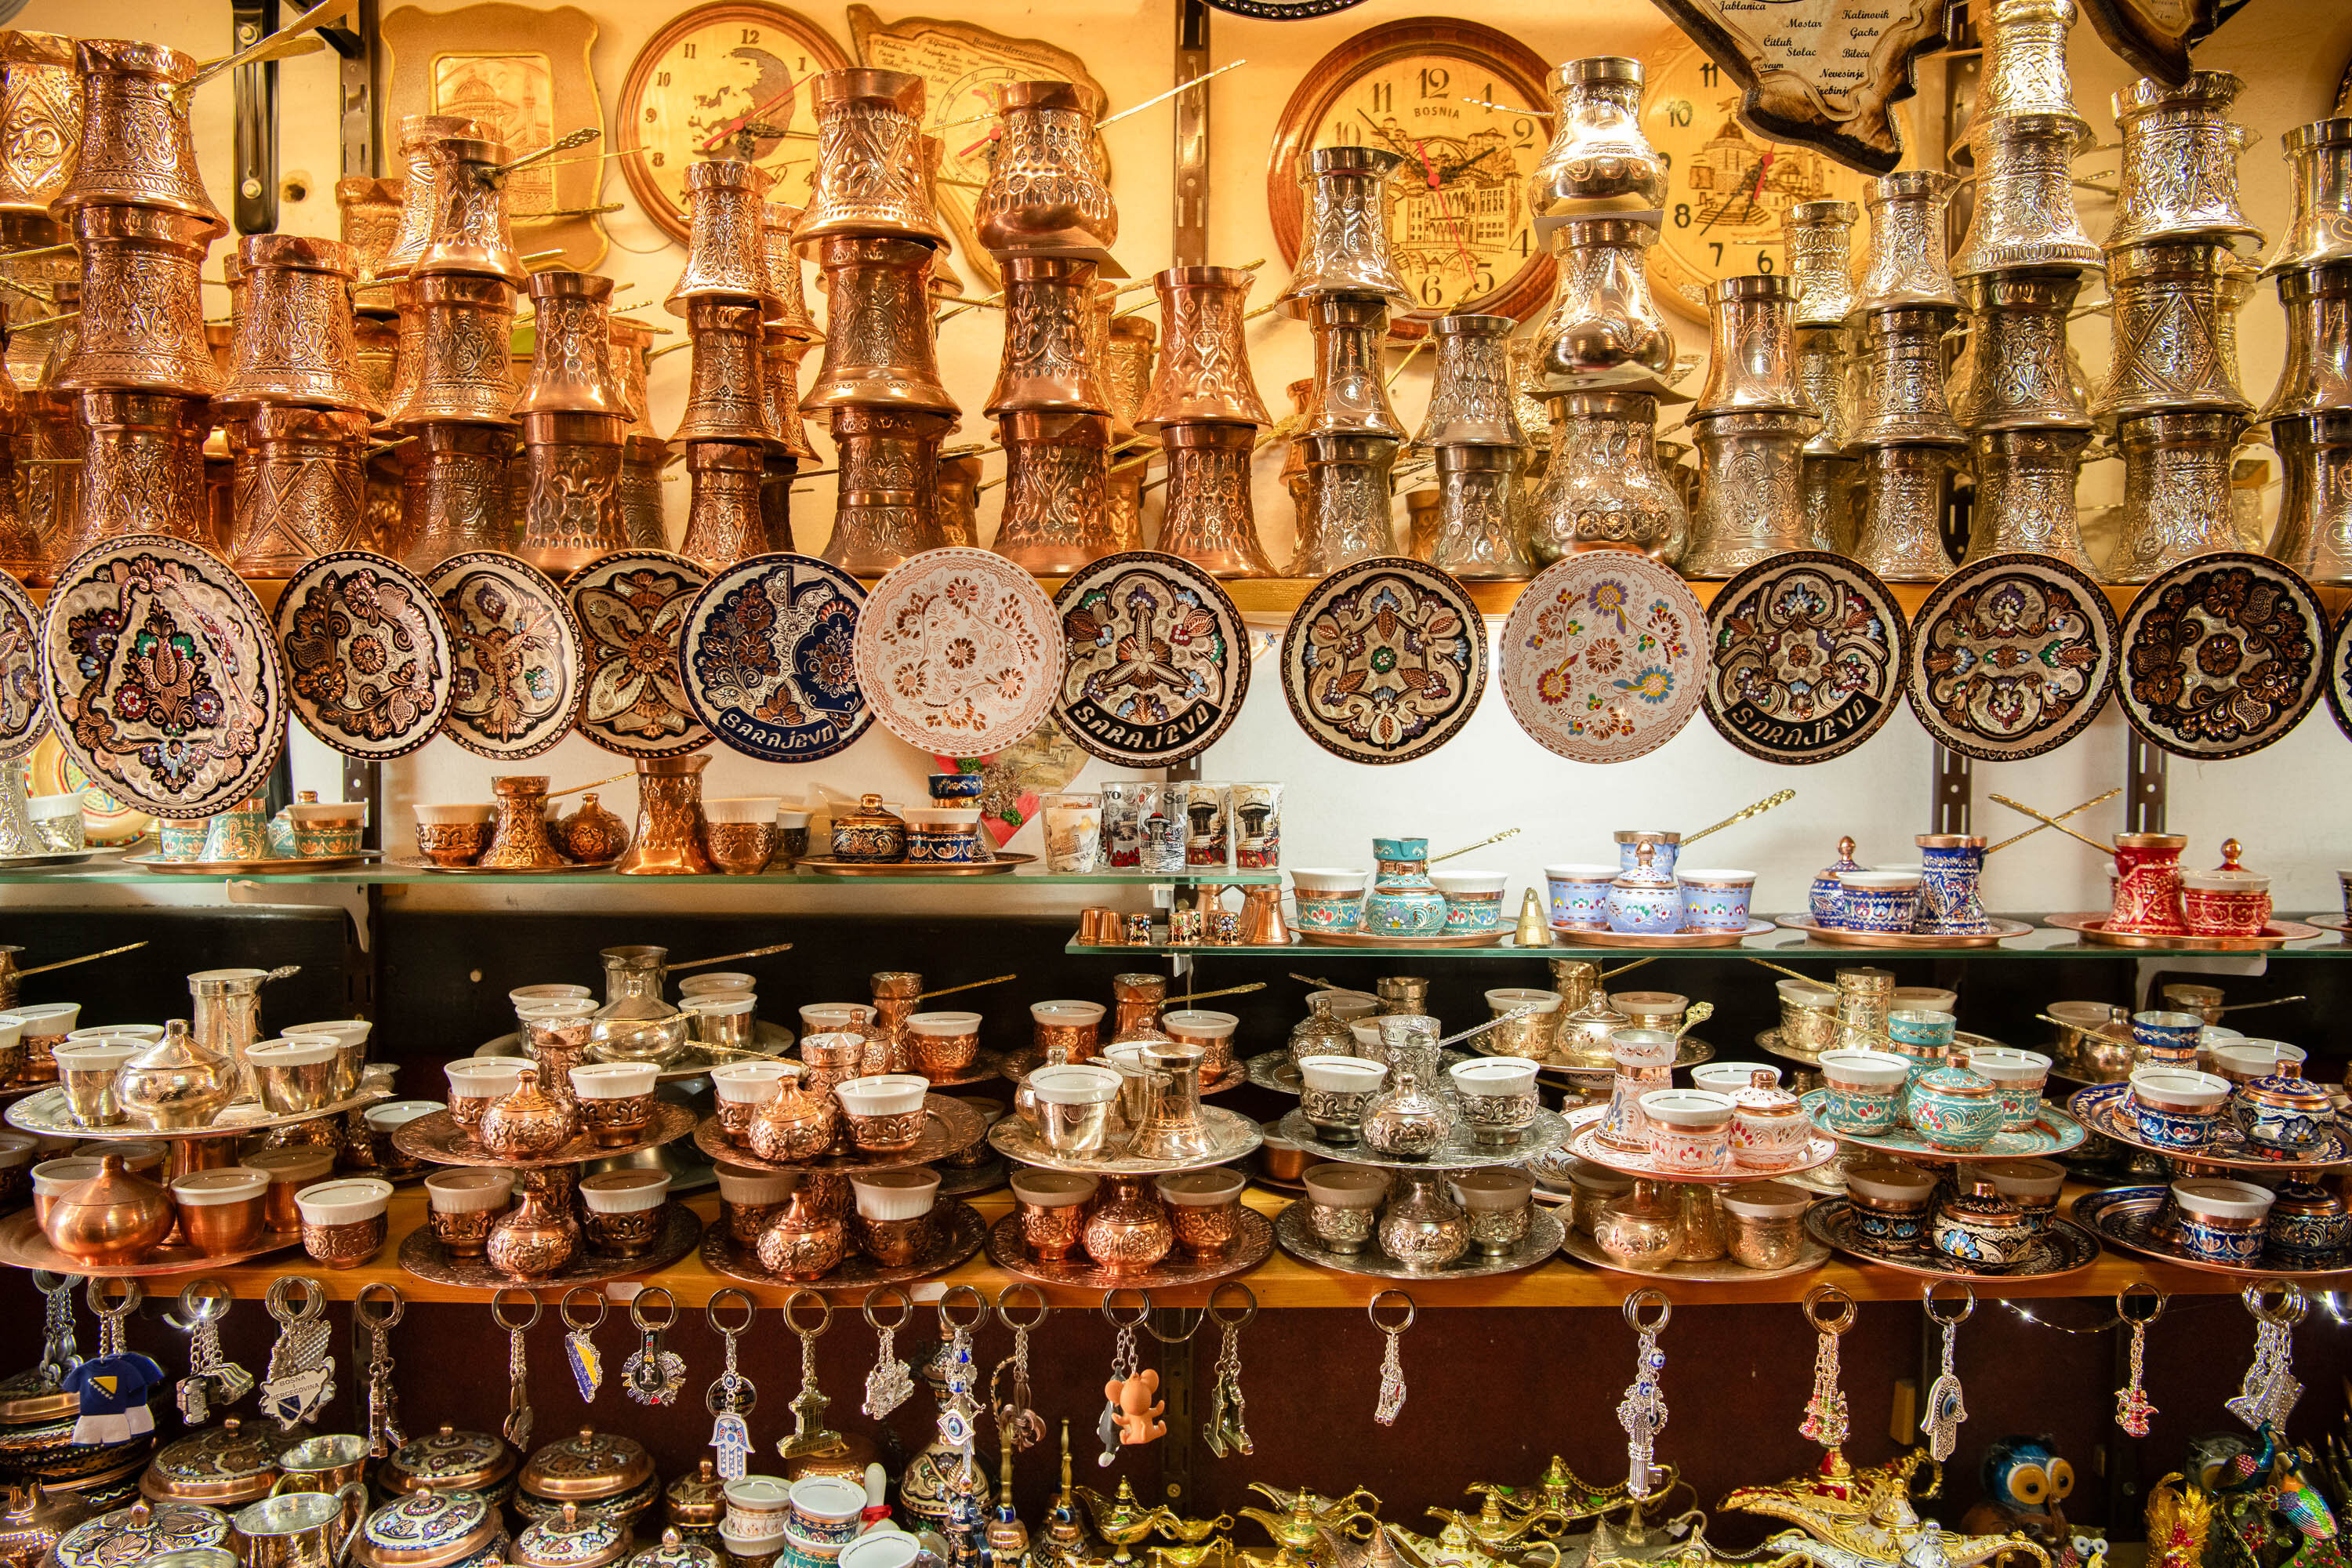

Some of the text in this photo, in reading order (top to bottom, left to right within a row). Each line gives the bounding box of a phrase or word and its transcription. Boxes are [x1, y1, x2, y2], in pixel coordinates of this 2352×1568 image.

[1719, 1, 1766, 13] Jablanica
[1842, 9, 1889, 20] Kalinovik
[1786, 18, 1823, 28] Mostar
[741, 29, 760, 45] 12
[1763, 34, 1793, 47] Čitluk
[1849, 27, 1879, 39] Gacko
[684, 43, 696, 59] 11
[1786, 47, 1817, 57] Stolac
[1842, 48, 1870, 58] Bileća
[798, 56, 806, 71] 1
[656, 72, 671, 87] 10
[1700, 62, 1719, 88] 11
[1819, 68, 1865, 81] Nevesinje
[1416, 68, 1450, 100] 12
[1369, 82, 1392, 114] 11
[1479, 82, 1493, 114] 1
[645, 108, 657, 123] 9
[1414, 106, 1460, 120] BOSNIA
[1665, 100, 1693, 127] 10
[1334, 122, 1361, 147] 10
[1512, 118, 1534, 149] 2
[652, 152, 665, 167] 8
[1674, 202, 1691, 229] 8
[1508, 228, 1534, 258] 4
[1709, 241, 1724, 267] 7
[1757, 249, 1774, 275] 6
[1473, 263, 1495, 294] 5
[1421, 274, 1442, 307] 6
[279, 1374, 307, 1387] BOSNA
[270, 1382, 320, 1401] HERCEGOVINA
